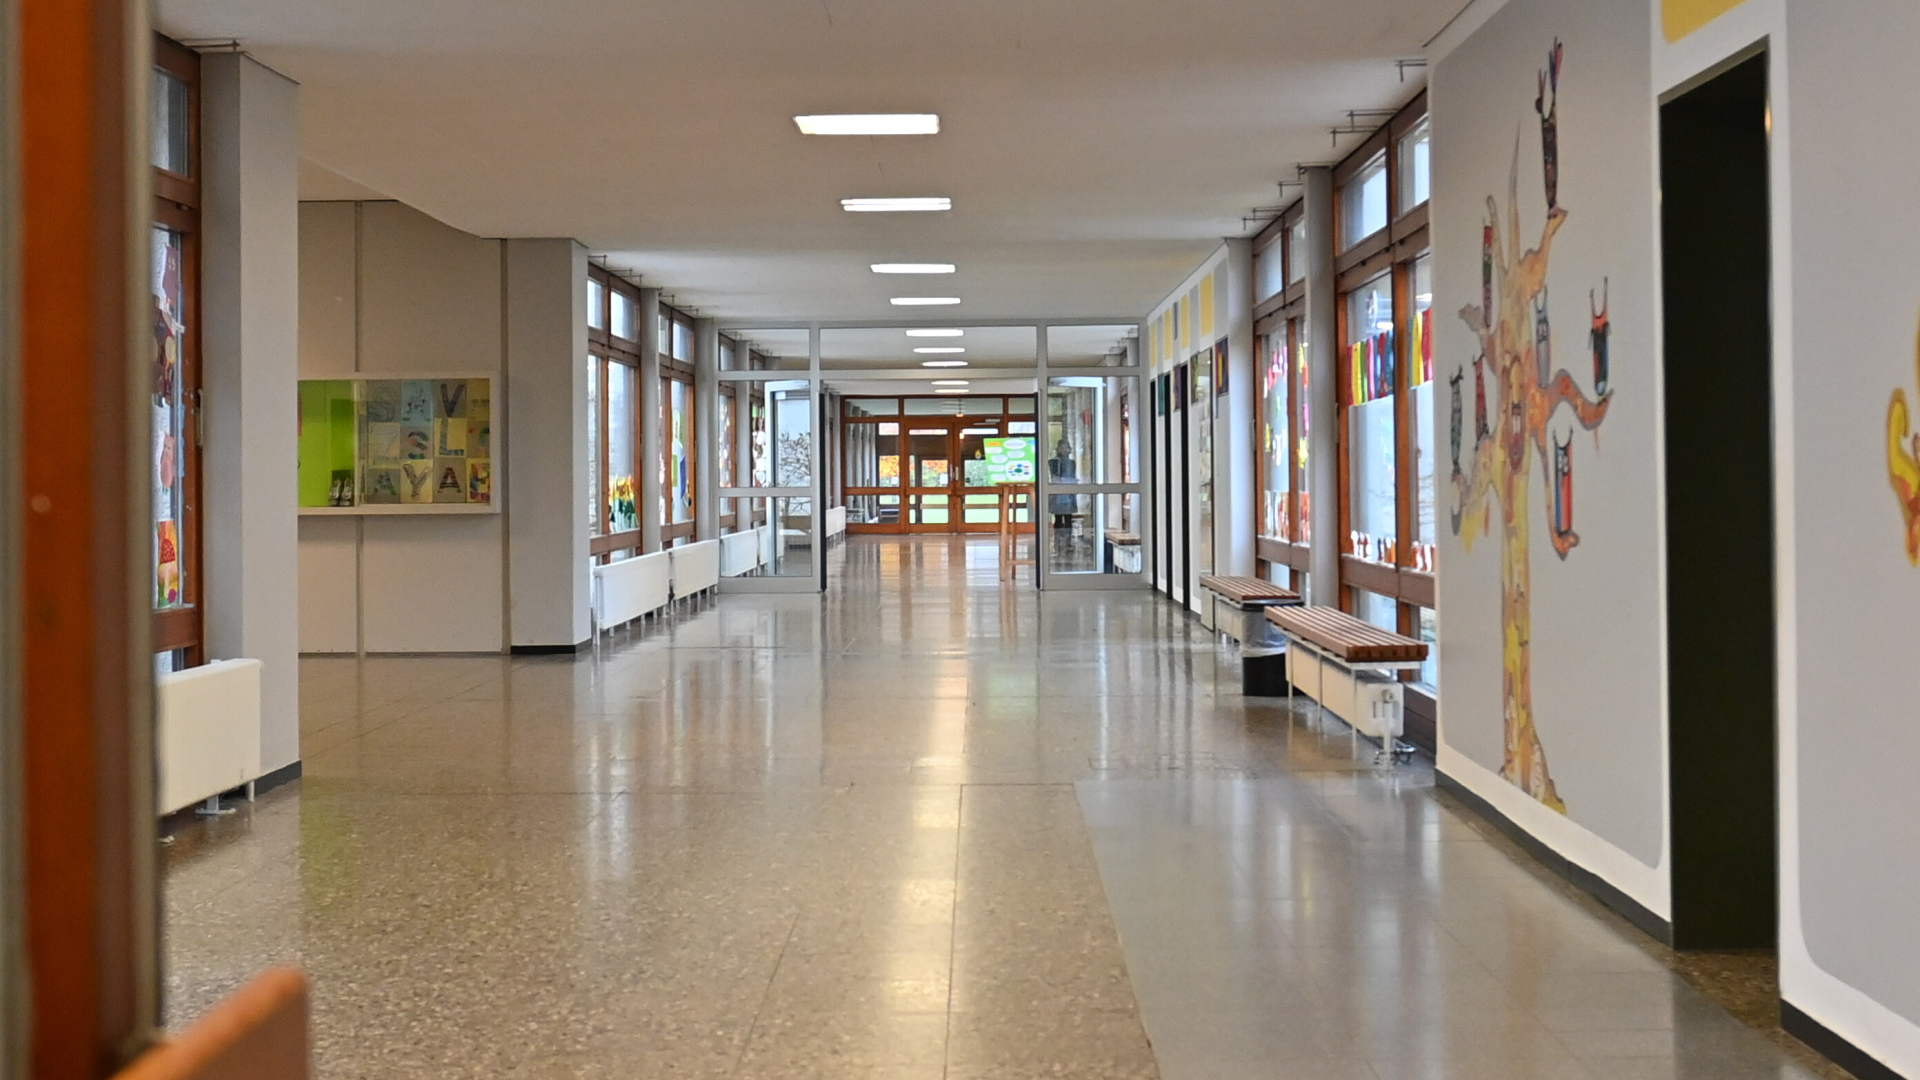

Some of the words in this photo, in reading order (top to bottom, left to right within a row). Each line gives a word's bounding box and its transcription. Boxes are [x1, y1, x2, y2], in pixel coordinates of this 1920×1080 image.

[440, 383, 465, 417] V
[438, 418, 464, 456] L
[403, 463, 431, 497] Y
[437, 467, 462, 493] A
